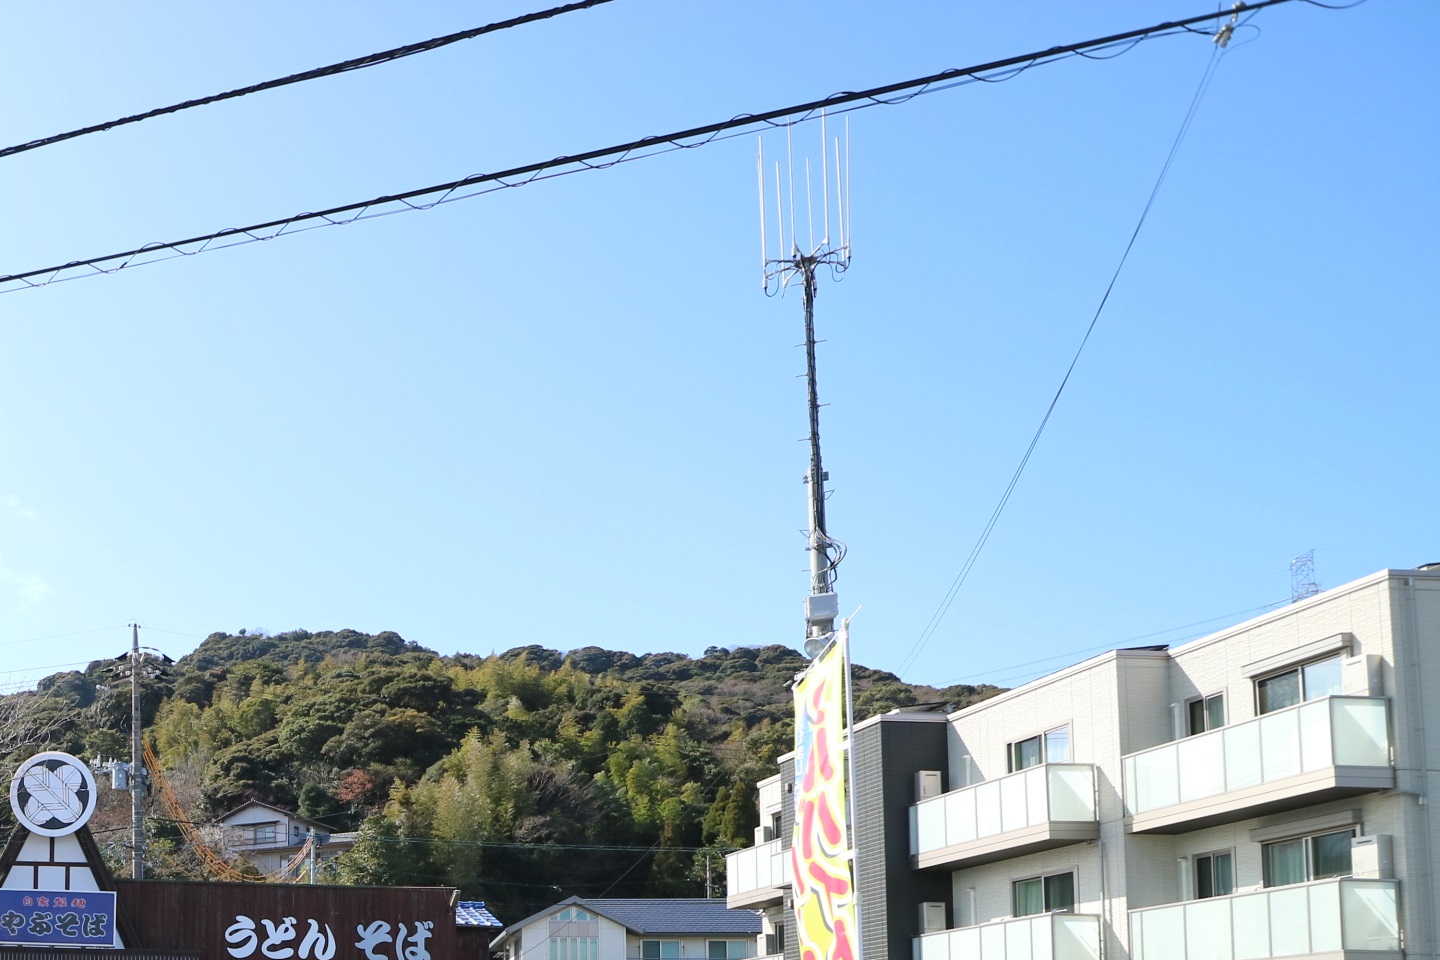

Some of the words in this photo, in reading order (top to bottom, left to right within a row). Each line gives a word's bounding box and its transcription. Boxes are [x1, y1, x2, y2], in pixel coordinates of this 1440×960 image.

[1, 910, 107, 937] やぶそば
[225, 915, 336, 960] うどん
